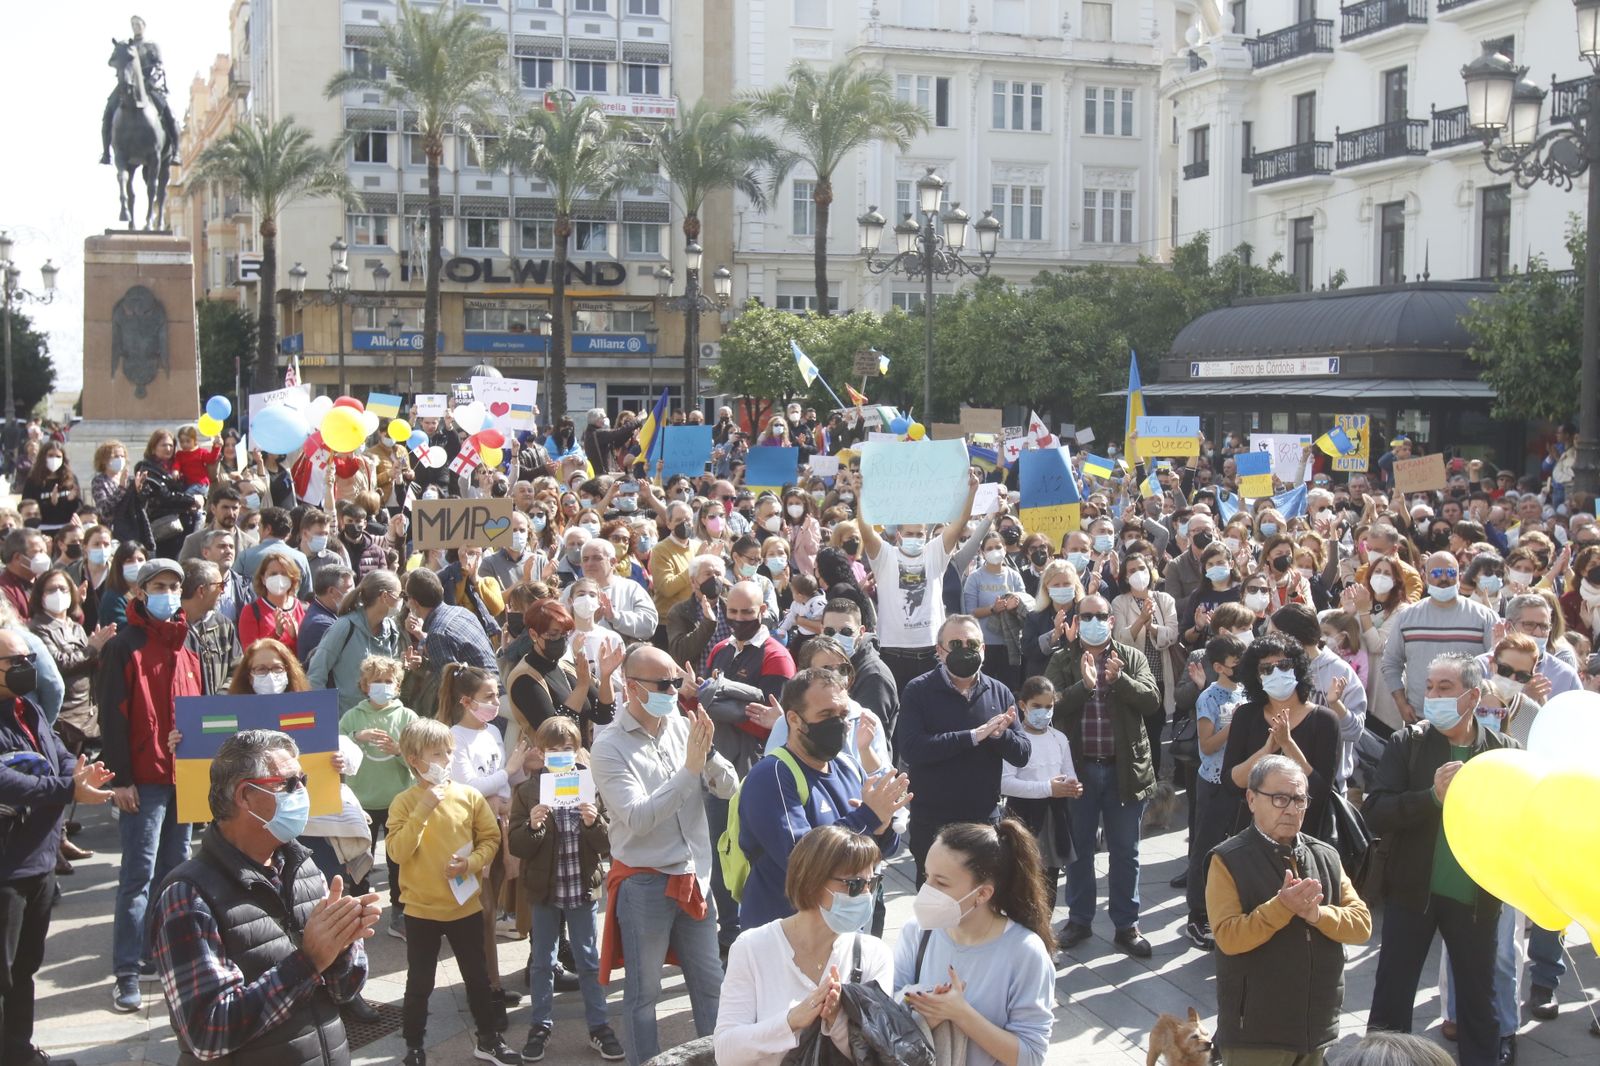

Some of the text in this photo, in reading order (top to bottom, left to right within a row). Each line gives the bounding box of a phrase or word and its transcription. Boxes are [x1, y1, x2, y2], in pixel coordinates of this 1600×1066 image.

[588, 337, 625, 350] Allianz
[1229, 362, 1254, 375] Turismo
[1255, 362, 1265, 374] de
[1266, 360, 1295, 375] Córdoba
[1144, 418, 1188, 434] No a la
[1338, 415, 1367, 429] STOP
[1337, 458, 1366, 470] PUTIN
[417, 506, 490, 541] МИР
